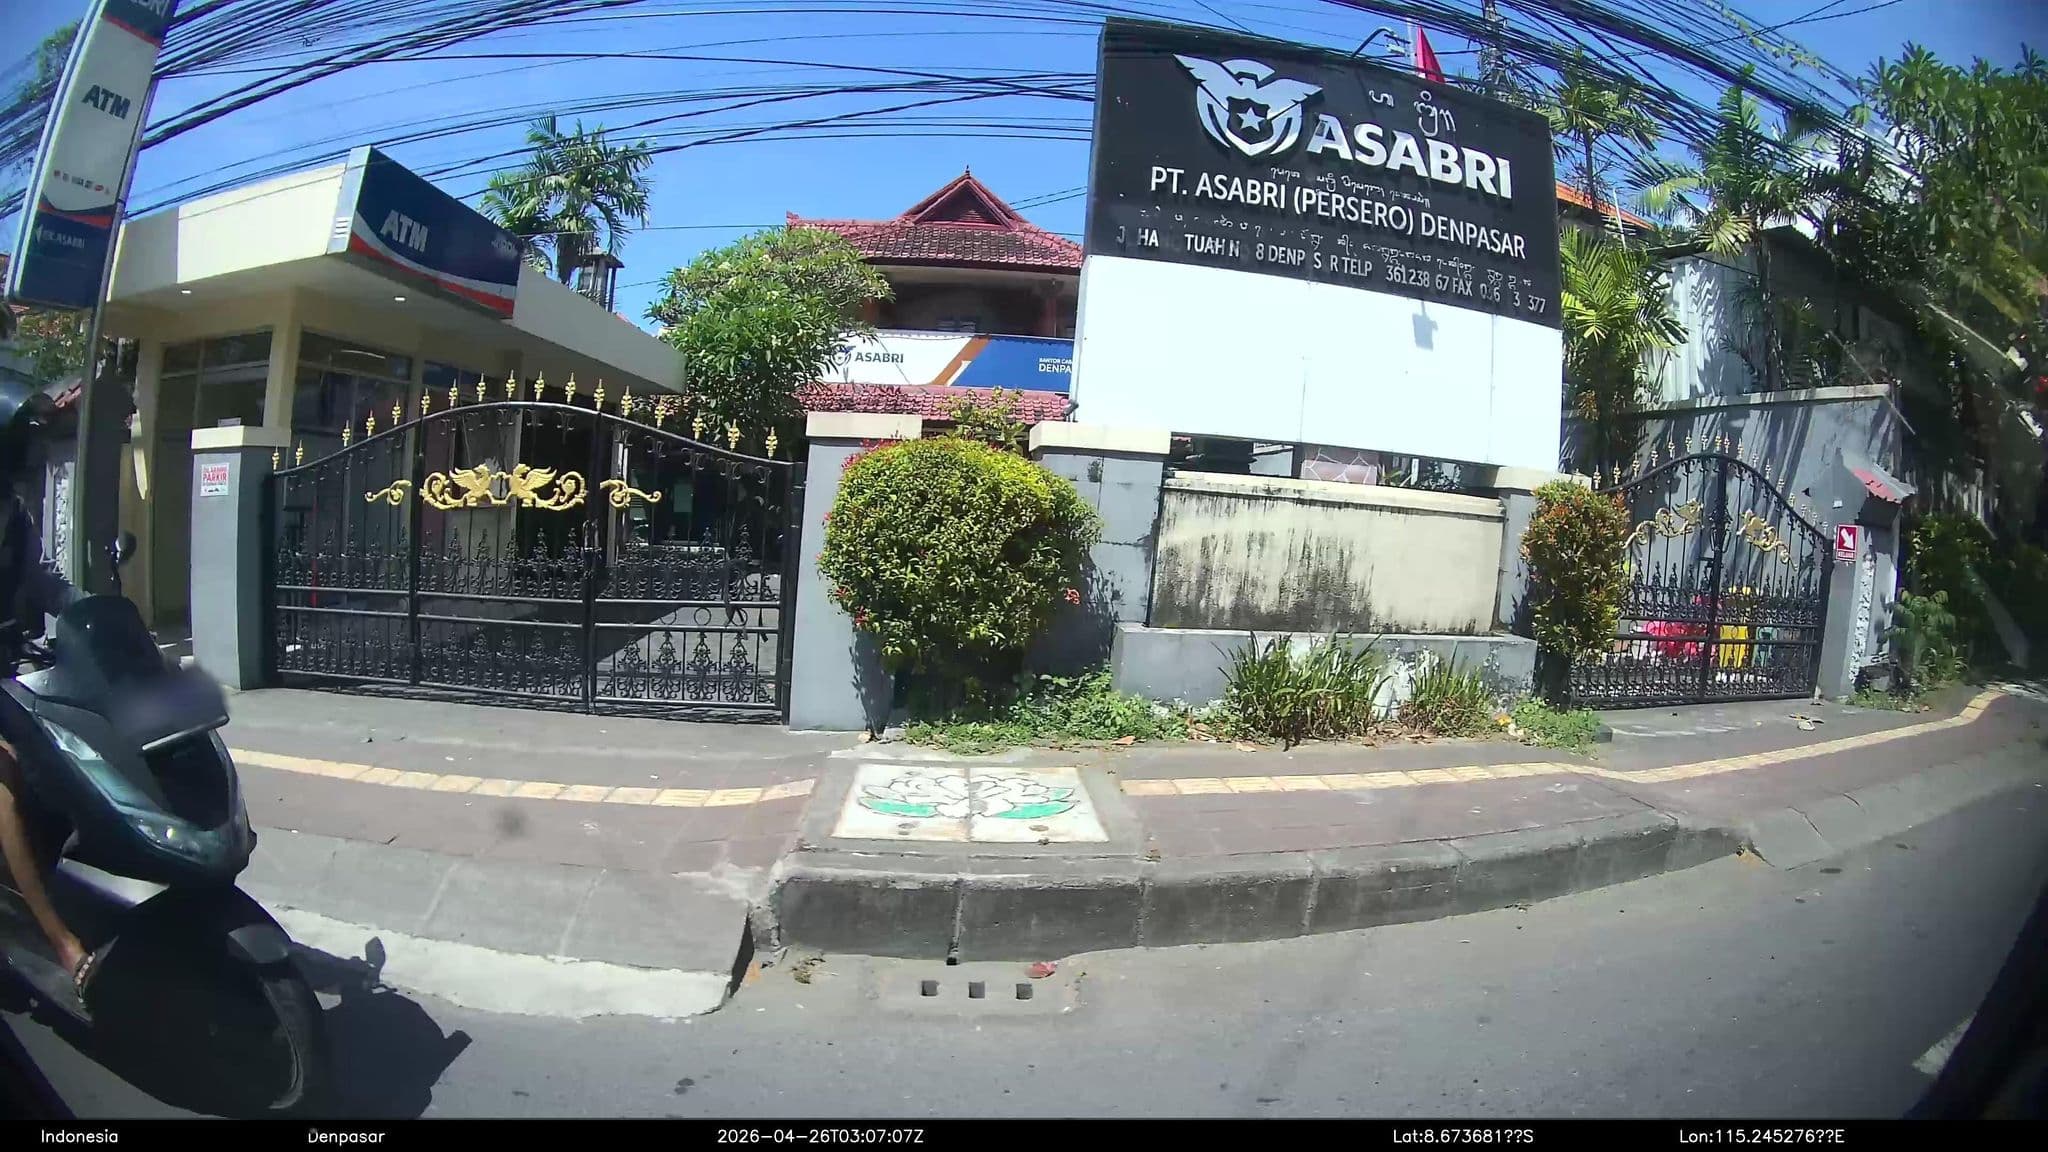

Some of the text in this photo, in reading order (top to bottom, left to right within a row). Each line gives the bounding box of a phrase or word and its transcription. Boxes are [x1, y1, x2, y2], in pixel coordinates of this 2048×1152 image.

[82, 84, 131, 120] ATM
[1306, 113, 1512, 199] ASABRI
[380, 209, 429, 253] ATM
[1150, 166, 1188, 196] PT.
[1195, 172, 1286, 209] ASABRI
[1293, 186, 1414, 236] (PERSERO)
[1421, 212, 1526, 259] DENPASAR
[1184, 233, 1225, 255] TUAH
[1341, 257, 1373, 277] TELP
[1452, 277, 1473, 297] FAX
[854, 351, 905, 364] ASABRI
